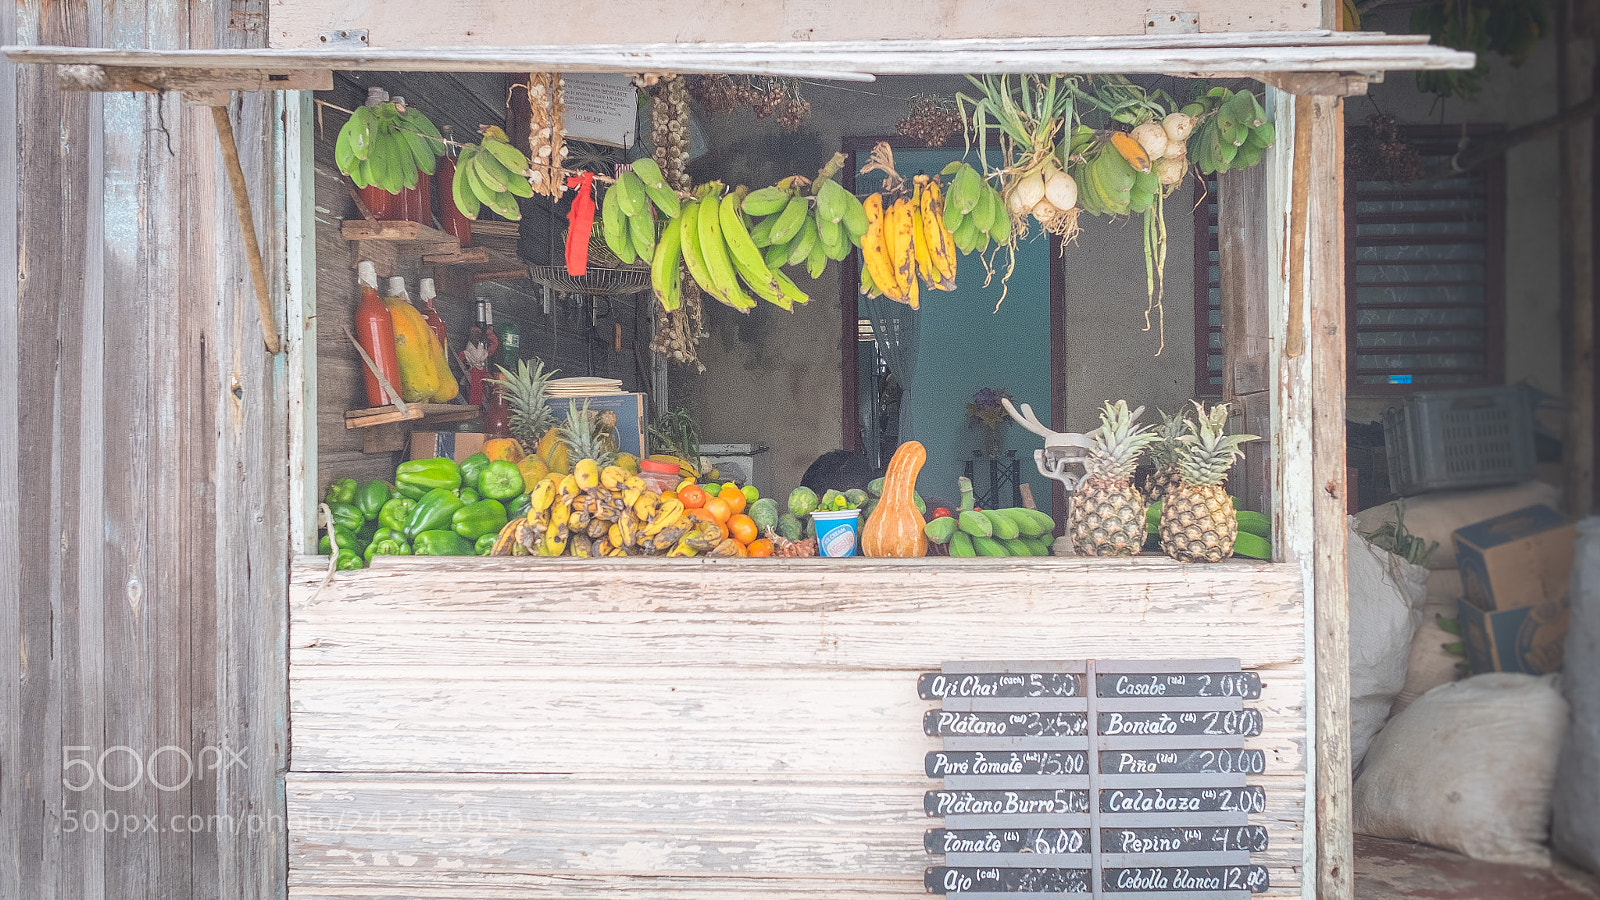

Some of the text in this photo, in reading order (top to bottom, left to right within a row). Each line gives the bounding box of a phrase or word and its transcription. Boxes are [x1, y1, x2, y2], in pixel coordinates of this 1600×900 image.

[829, 527, 847, 539] CREAM
[1115, 675, 1166, 695] Casabe
[937, 712, 1007, 735] Plátano
[1105, 712, 1178, 735] Boniato
[972, 752, 1024, 774] tomate
[1036, 752, 1084, 776] 15.00
[1118, 752, 1158, 774] Piña
[1200, 748, 1264, 774] 20.00
[936, 791, 1002, 815] Plátano
[1002, 791, 1055, 815] Burro
[1109, 788, 1201, 812] Calabaza
[943, 830, 1001, 853] tomate
[1035, 828, 1083, 854] 6.00
[1121, 830, 1182, 854] Pepino
[943, 869, 973, 894] Ajo
[976, 868, 1000, 882] (cab)
[1117, 866, 1267, 890] Cebolla blanca 12.00
